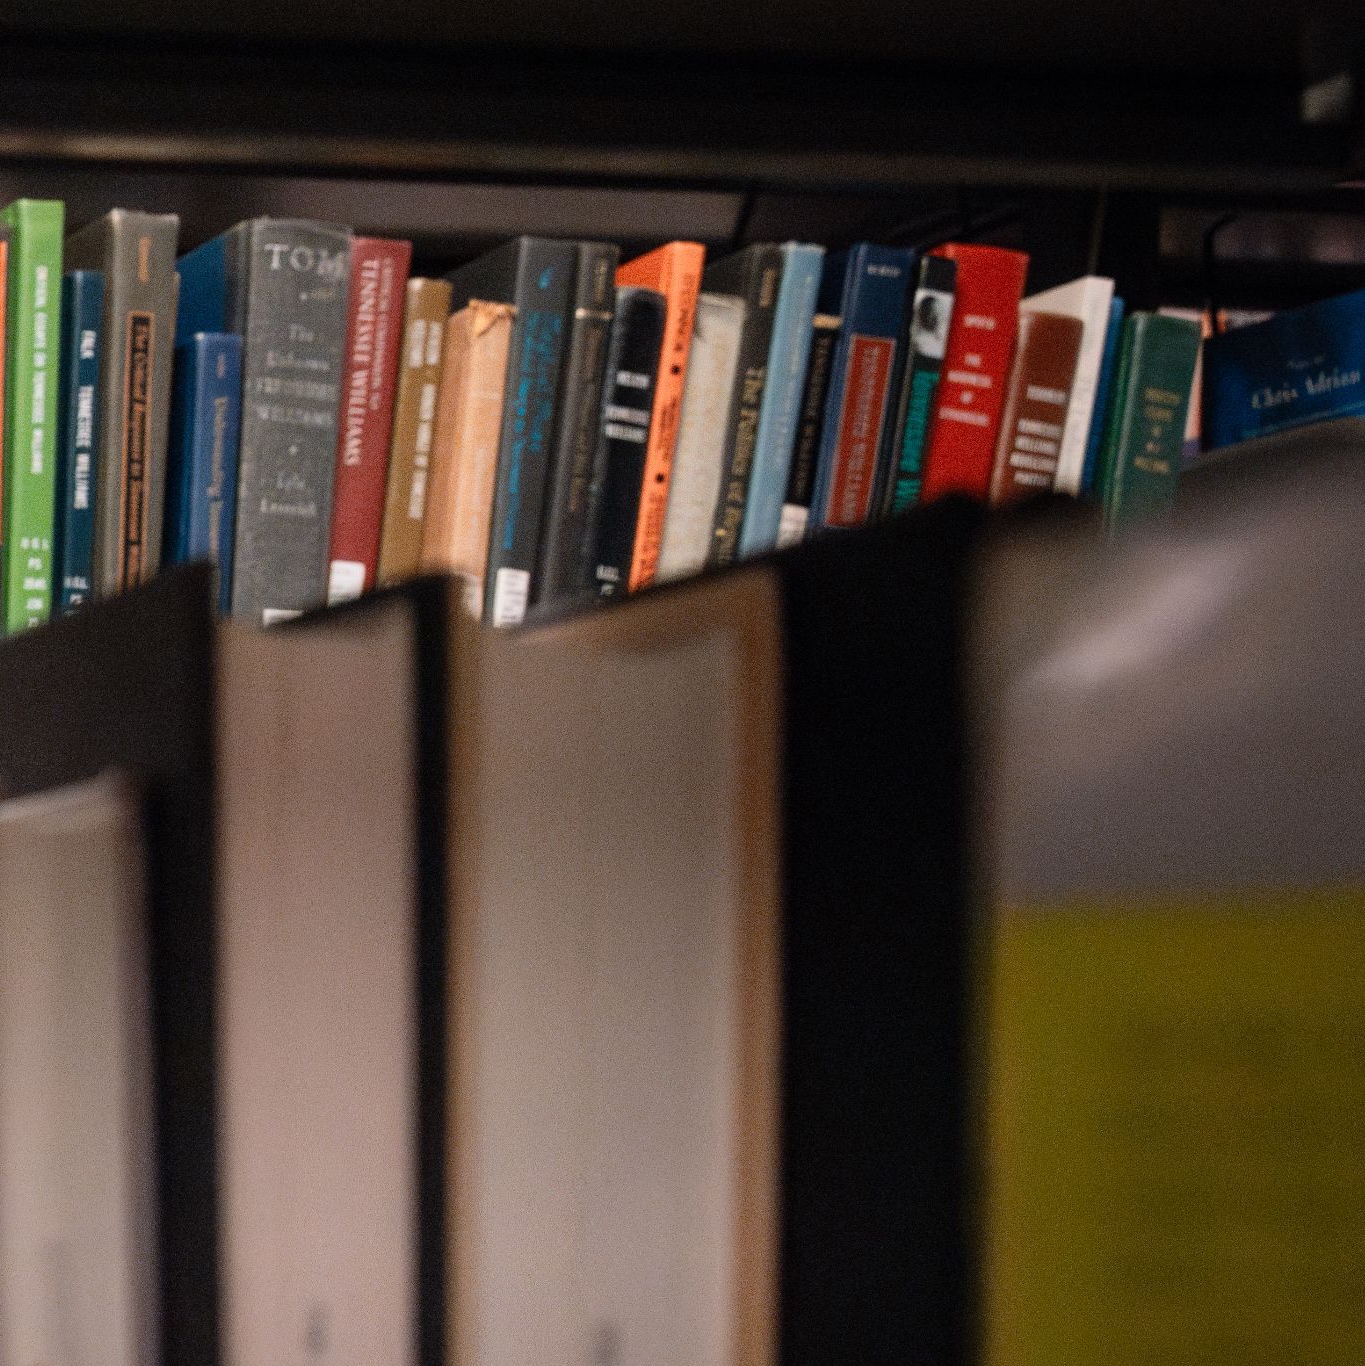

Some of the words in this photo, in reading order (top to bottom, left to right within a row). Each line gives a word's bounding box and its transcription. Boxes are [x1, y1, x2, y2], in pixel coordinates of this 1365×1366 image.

[263, 243, 345, 279] TOM
[352, 259, 381, 362] TENNESSEE
[344, 369, 369, 466] WILLIAMS
